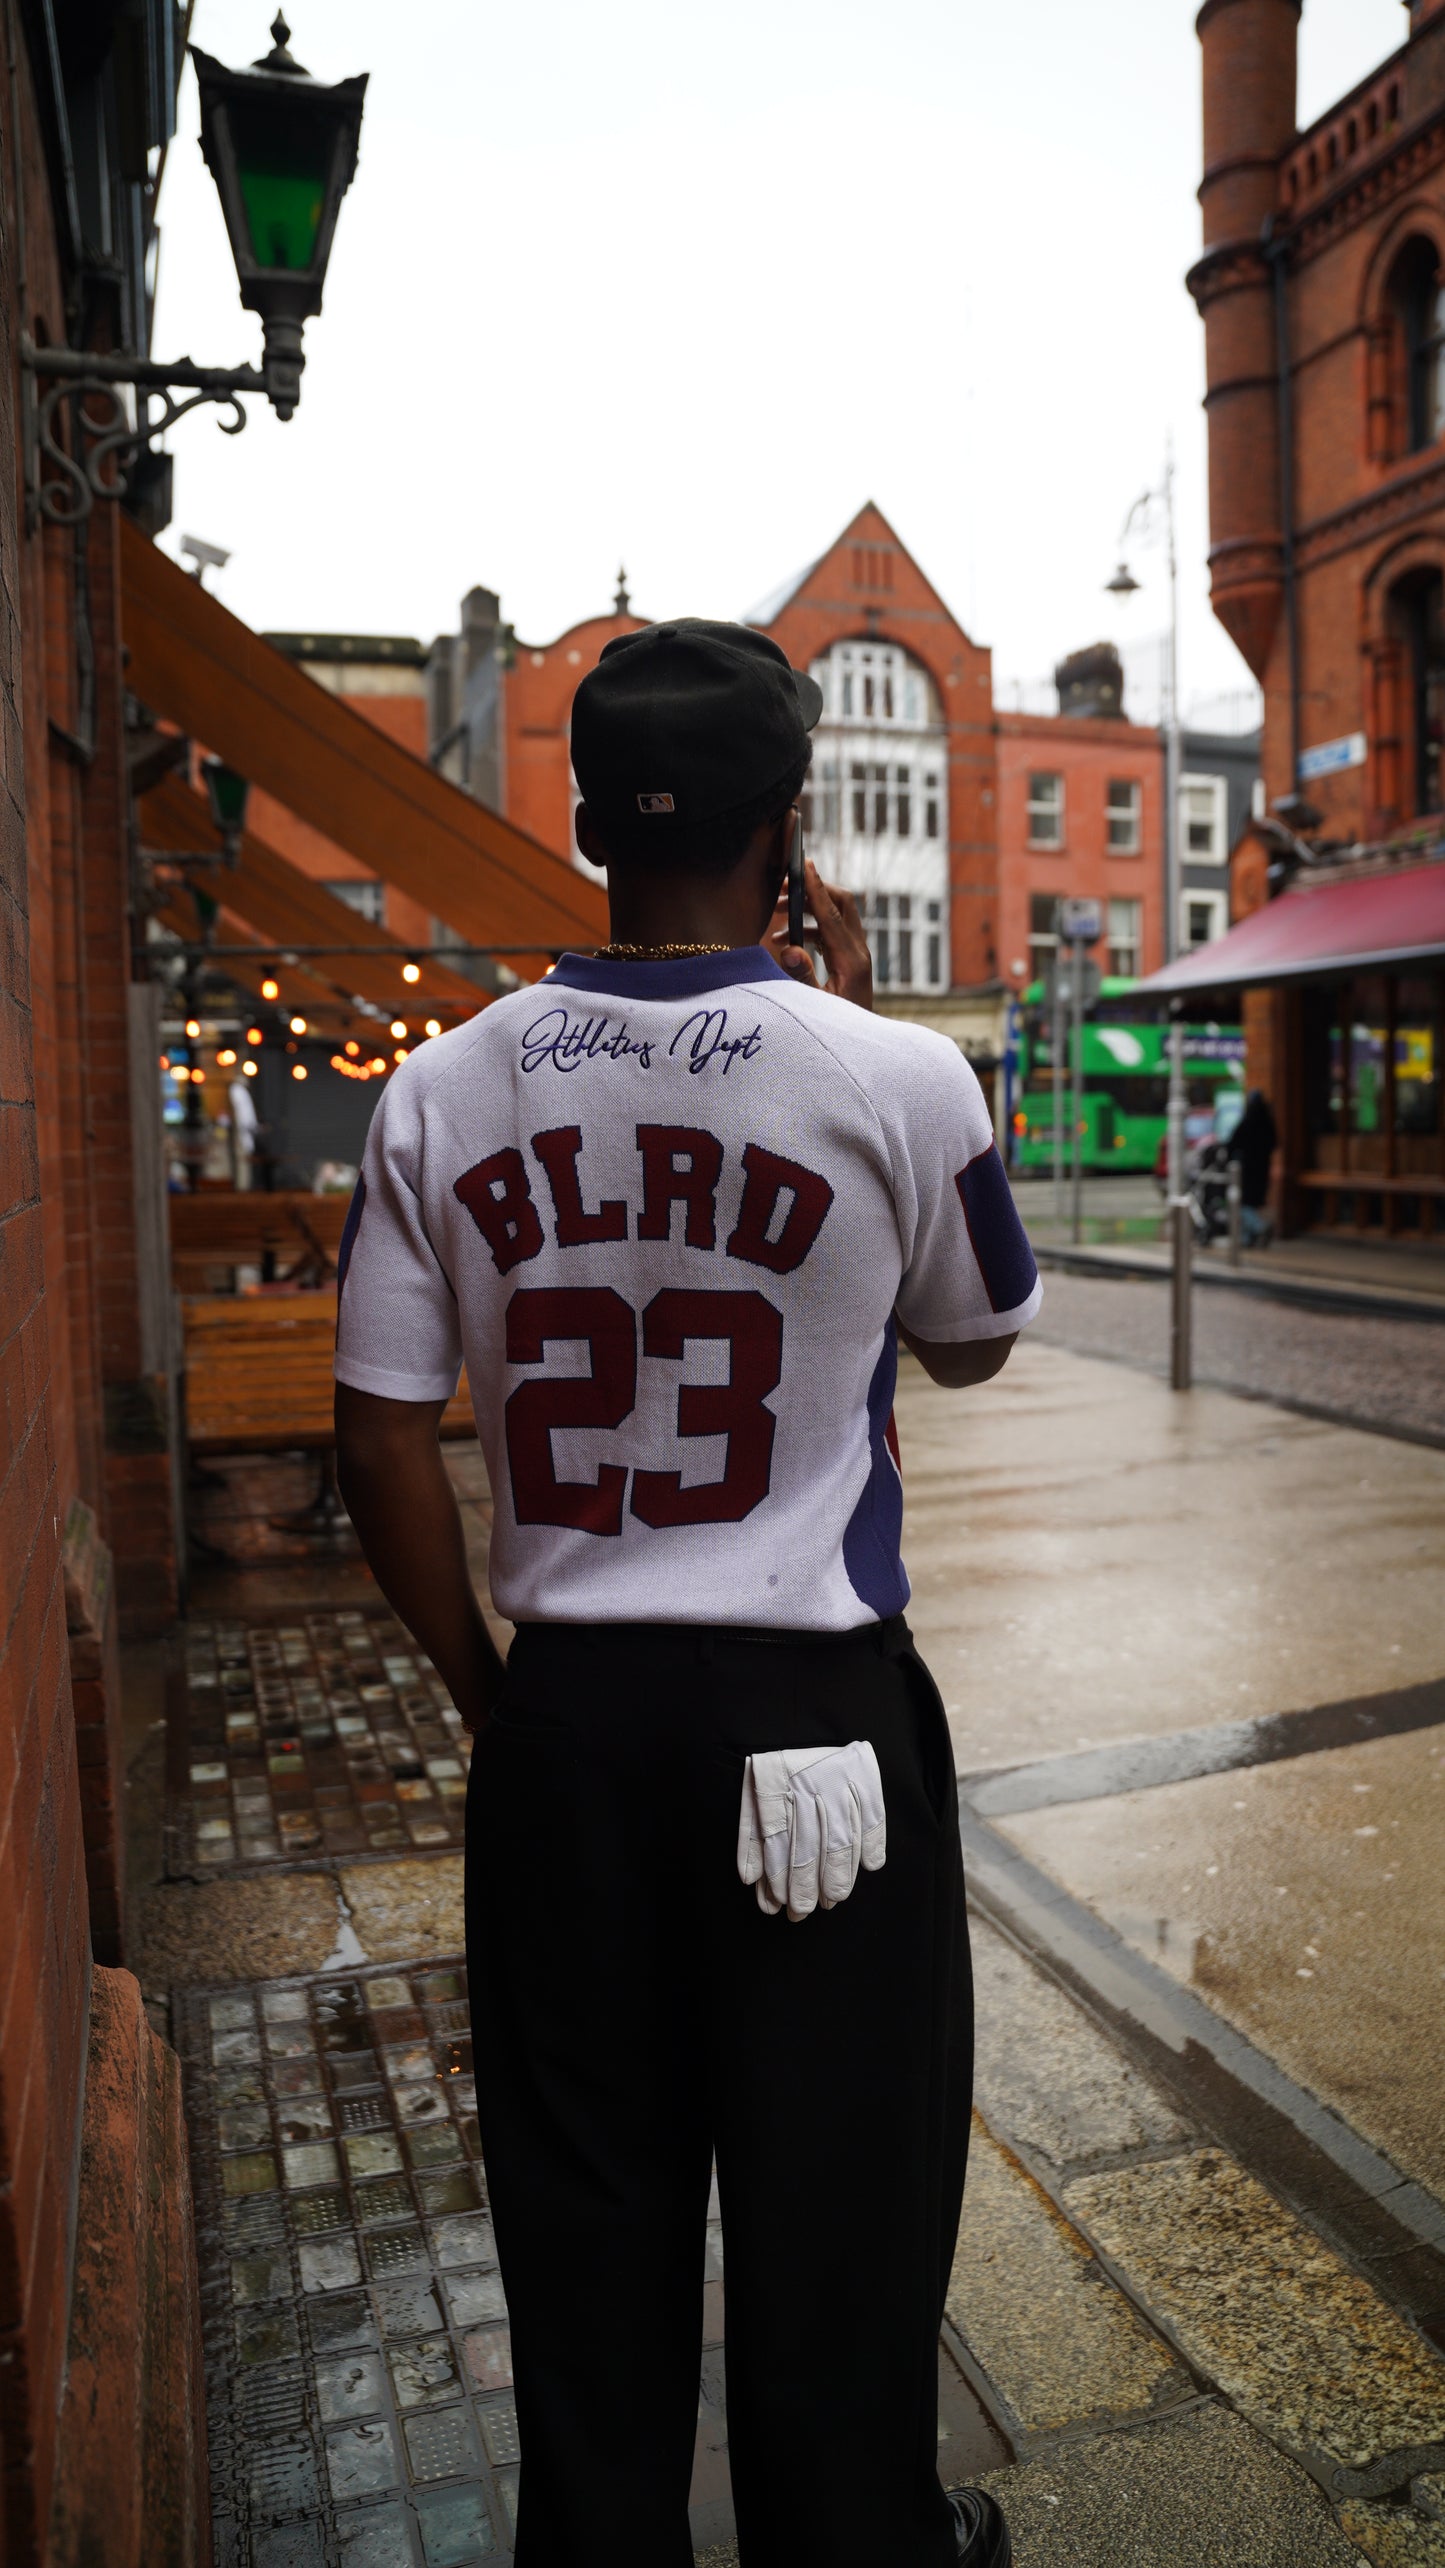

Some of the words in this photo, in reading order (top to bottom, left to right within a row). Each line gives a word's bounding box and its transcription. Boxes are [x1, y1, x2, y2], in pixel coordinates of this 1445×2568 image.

[521, 1009, 655, 1073] Athletics
[669, 1009, 762, 1075] Dept
[453, 1123, 834, 1276] BLRD
[505, 1286, 784, 1536] 23
